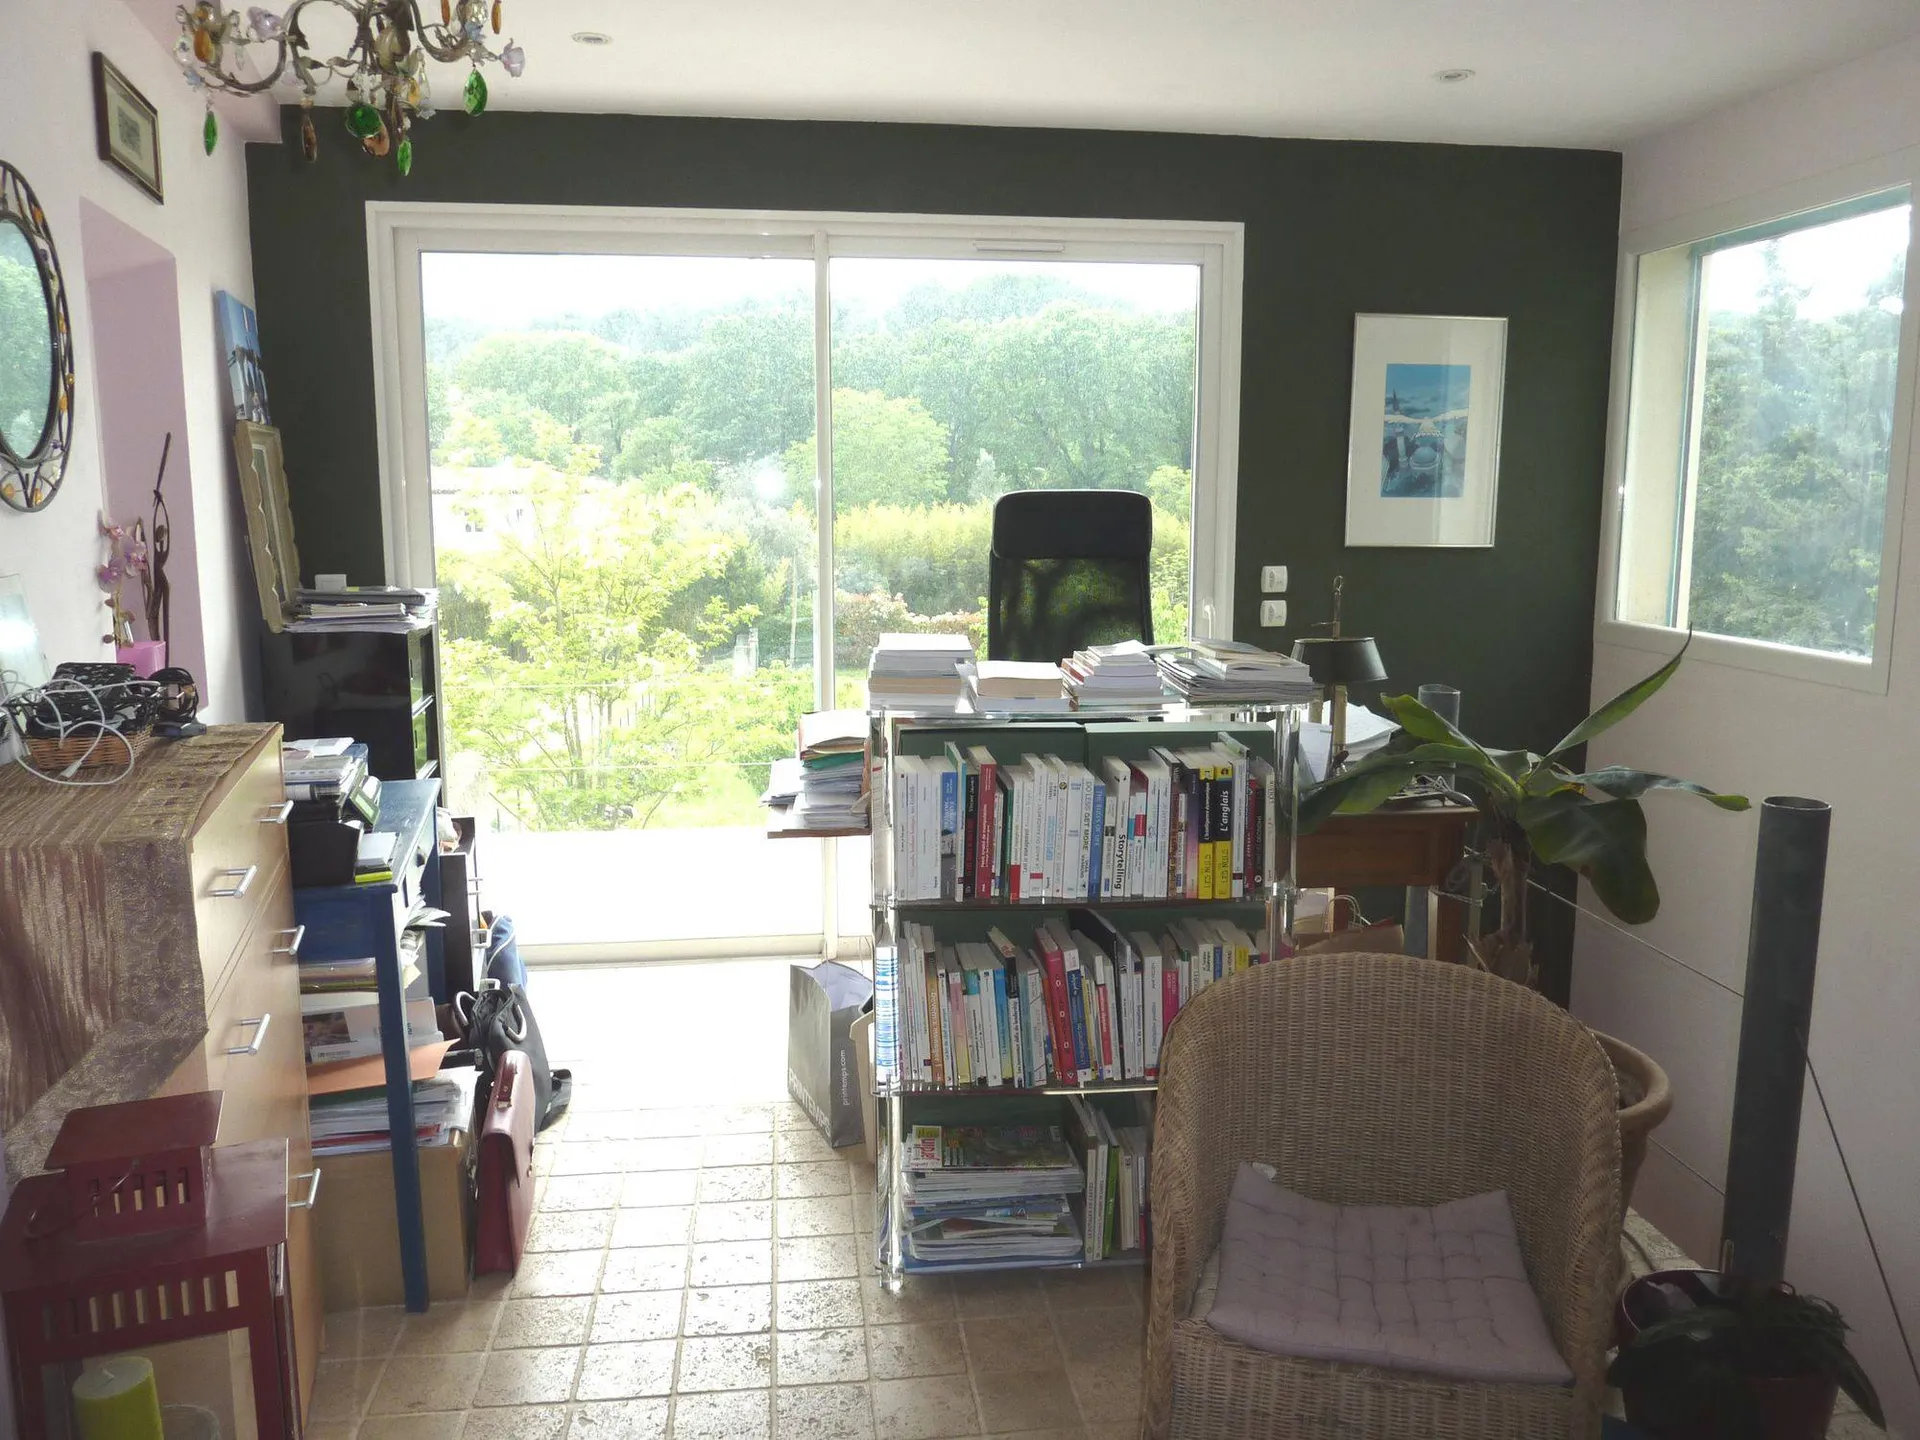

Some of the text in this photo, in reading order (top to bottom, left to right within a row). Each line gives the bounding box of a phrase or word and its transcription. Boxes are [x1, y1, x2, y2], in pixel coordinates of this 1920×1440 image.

[1084, 793, 1092, 811] LESS
[1085, 782, 1093, 792] DO
[1203, 782, 1211, 811] économique
[1219, 789, 1230, 832] L'anglais
[1082, 829, 1090, 851] MORE
[1114, 834, 1127, 890] Storytelling
[839, 1049, 851, 1106] printemps.com
[789, 1066, 832, 1138] PRINTEMPS
